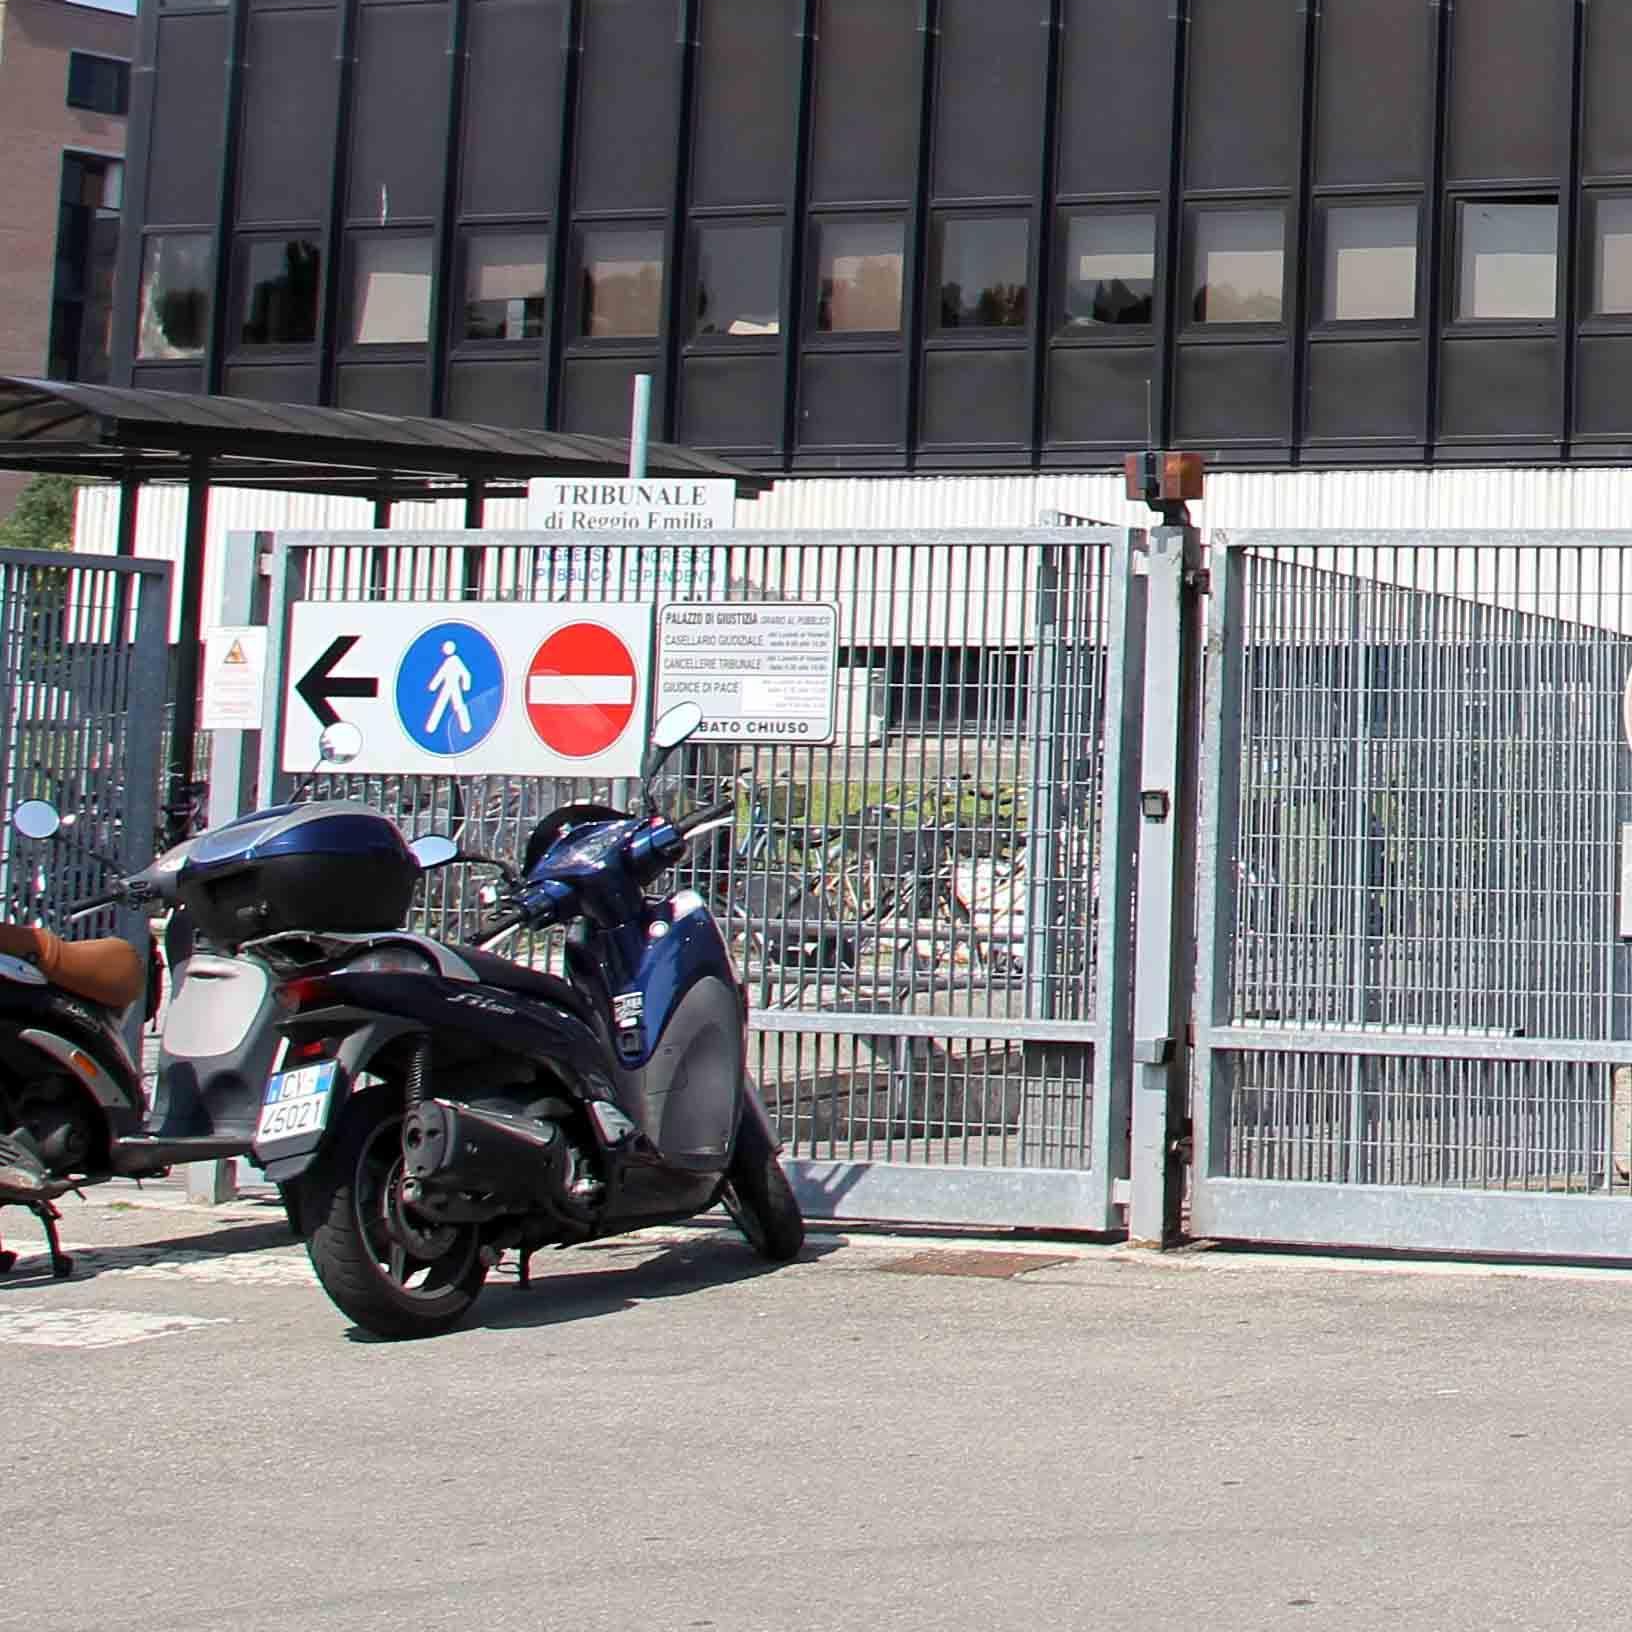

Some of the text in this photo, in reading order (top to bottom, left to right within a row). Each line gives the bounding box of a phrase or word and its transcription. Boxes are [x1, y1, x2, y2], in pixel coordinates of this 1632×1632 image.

[555, 484, 706, 506] TRIBUNALE
[544, 511, 563, 530] di
[648, 511, 714, 530] Emilia
[665, 612, 701, 625] PALAZZO
[705, 612, 715, 625] DI
[716, 612, 758, 625] GIUSTIZIA
[700, 721, 809, 734] BATO CHIUSO
